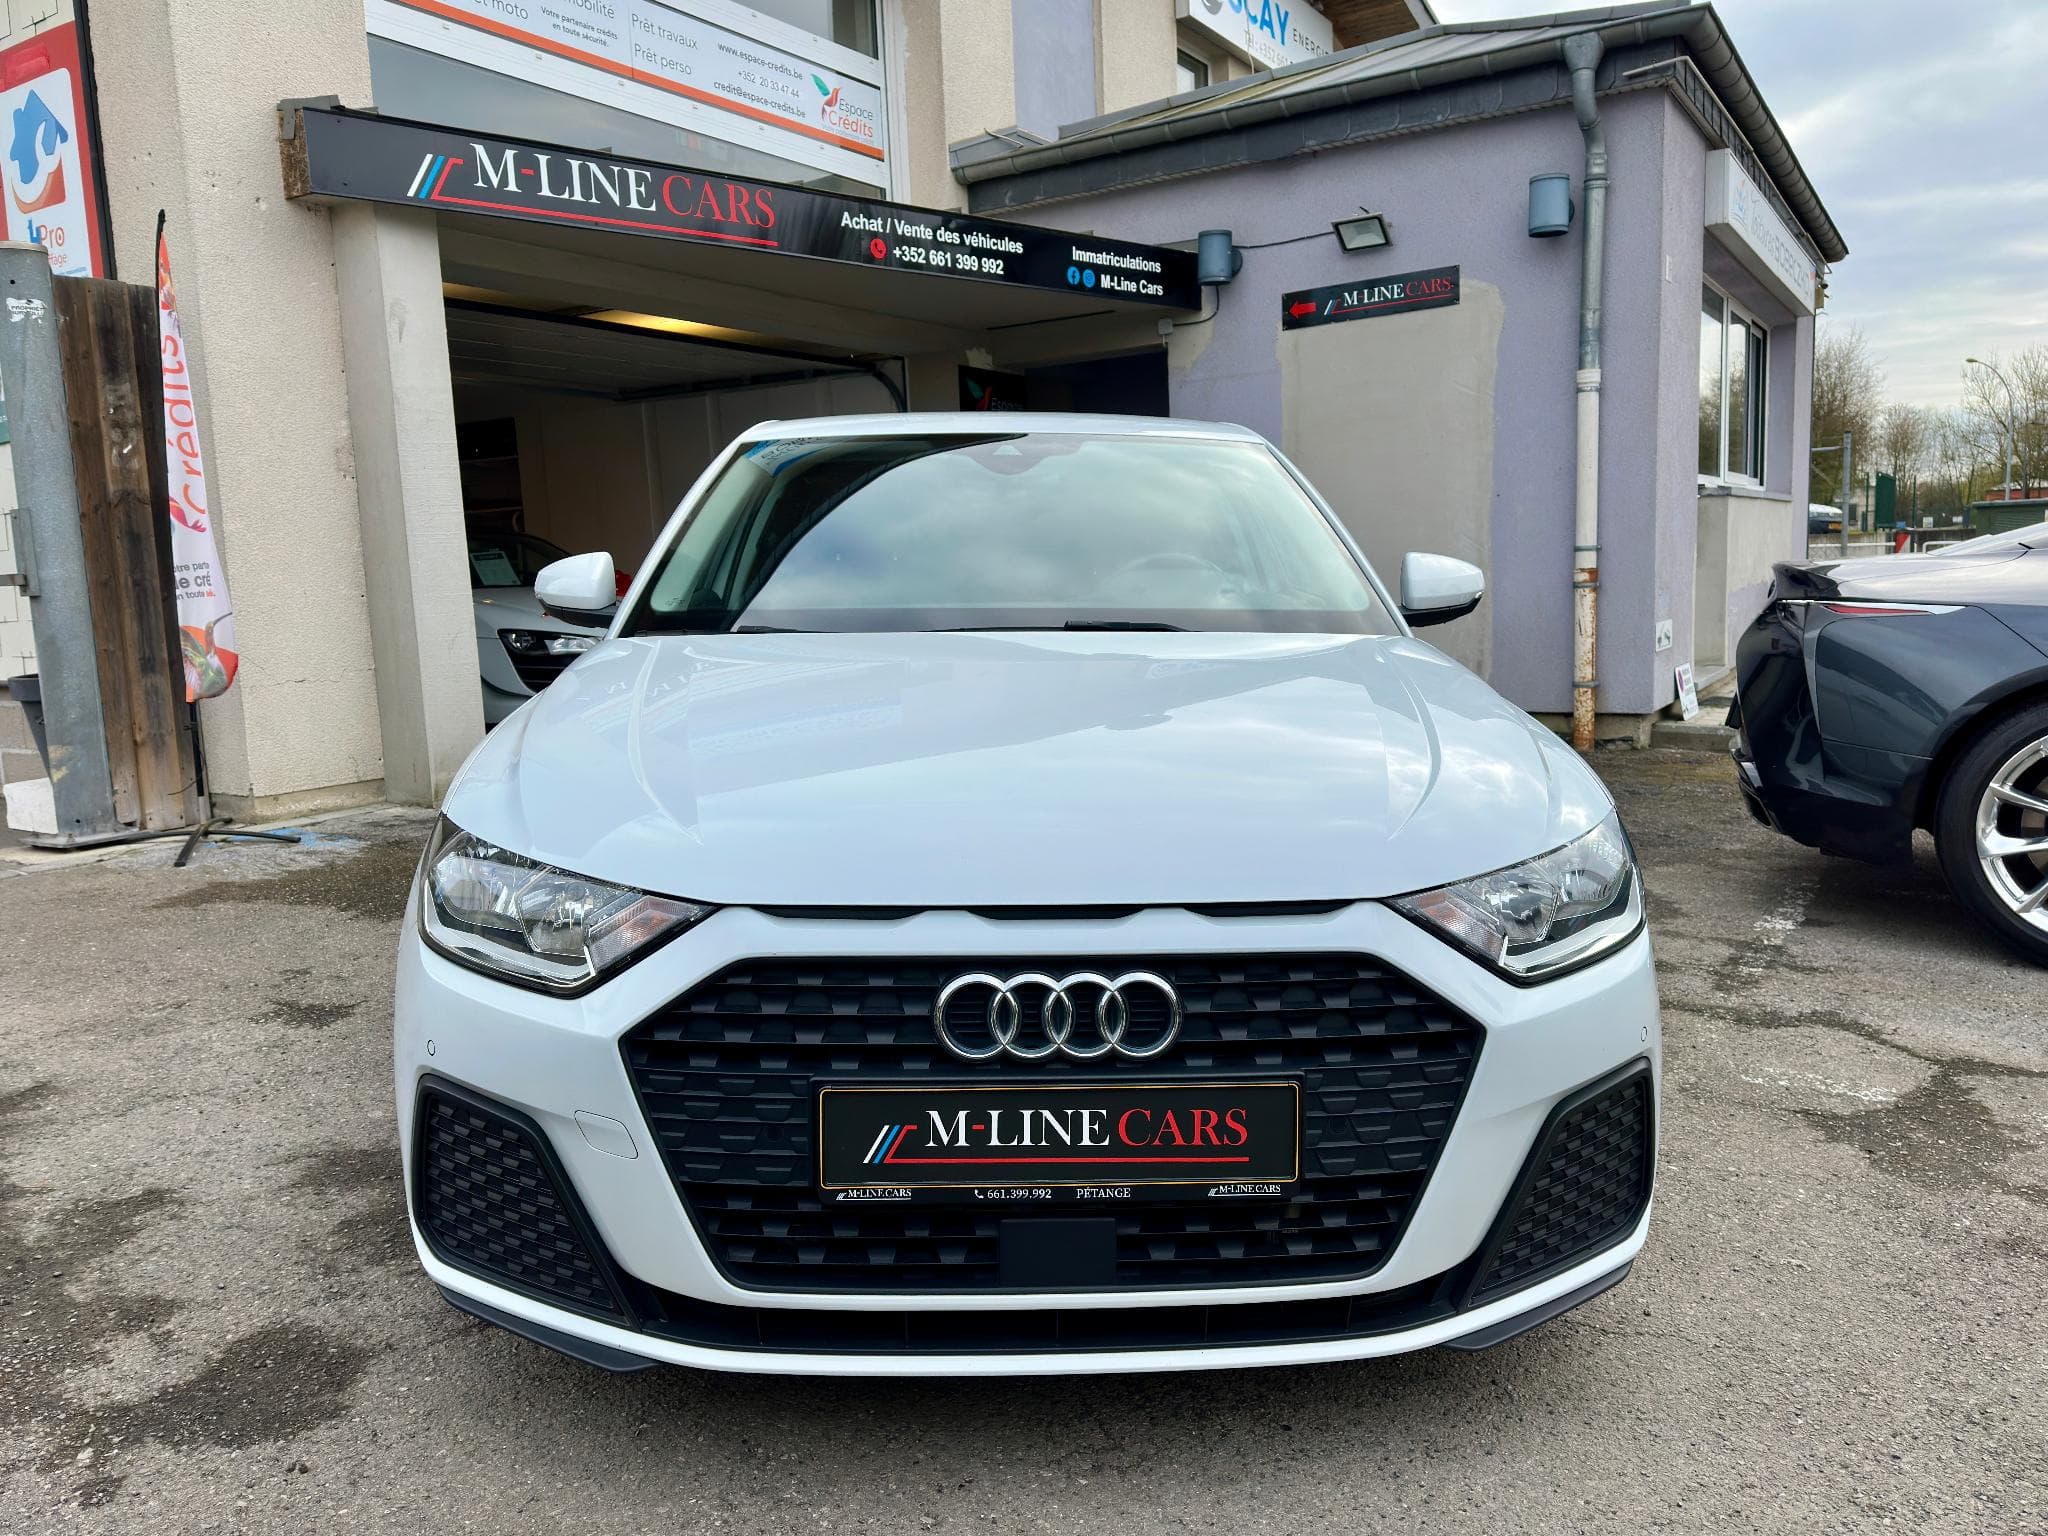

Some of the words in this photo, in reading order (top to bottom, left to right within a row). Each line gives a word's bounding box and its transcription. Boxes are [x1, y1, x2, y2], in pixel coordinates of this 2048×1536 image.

[492, 0, 529, 20] moto
[541, 6, 560, 19] Votre
[561, 15, 595, 33] partenaire
[552, 23, 561, 31] en
[562, 25, 580, 37] toute
[631, 13, 655, 35] Prêt
[658, 25, 698, 50] travaux
[634, 42, 657, 64] Prêt
[660, 56, 692, 75] perso
[717, 42, 804, 80] www.espace-credits.be
[738, 70, 756, 84] +352
[759, 77, 769, 88] 20
[770, 80, 779, 92] 33
[780, 84, 789, 95] 47
[791, 88, 799, 98] 44
[713, 81, 806, 118] credit@espace-credits.be
[839, 98, 873, 121] Espace
[829, 110, 873, 138] Crédits
[469, 142, 657, 212] M-LINE
[661, 174, 775, 229] CARS
[841, 210, 883, 233] Achat
[886, 218, 891, 234] /
[893, 218, 934, 241] Vente
[936, 225, 961, 245] des
[963, 231, 1024, 255] véhicules
[892, 246, 926, 265] +352
[929, 251, 952, 269] 661
[956, 254, 978, 272] 399
[981, 257, 1004, 275] 992
[1072, 245, 1162, 274] Immatriculations
[1100, 274, 1138, 293] M-Line
[1139, 278, 1164, 297] Cars
[1343, 283, 1405, 308] M-LINE
[1406, 275, 1454, 297] CARS
[925, 1108, 1110, 1148] M-LINE
[1117, 1107, 1250, 1148] CARS
[848, 1188, 884, 1198] M-LINE
[885, 1188, 912, 1198] CARS
[986, 1188, 1053, 1200] 661.399.992
[1076, 1186, 1131, 1199] PÉTANGE
[1218, 1184, 1255, 1195] M-LINE
[1255, 1184, 1282, 1194] CARS
